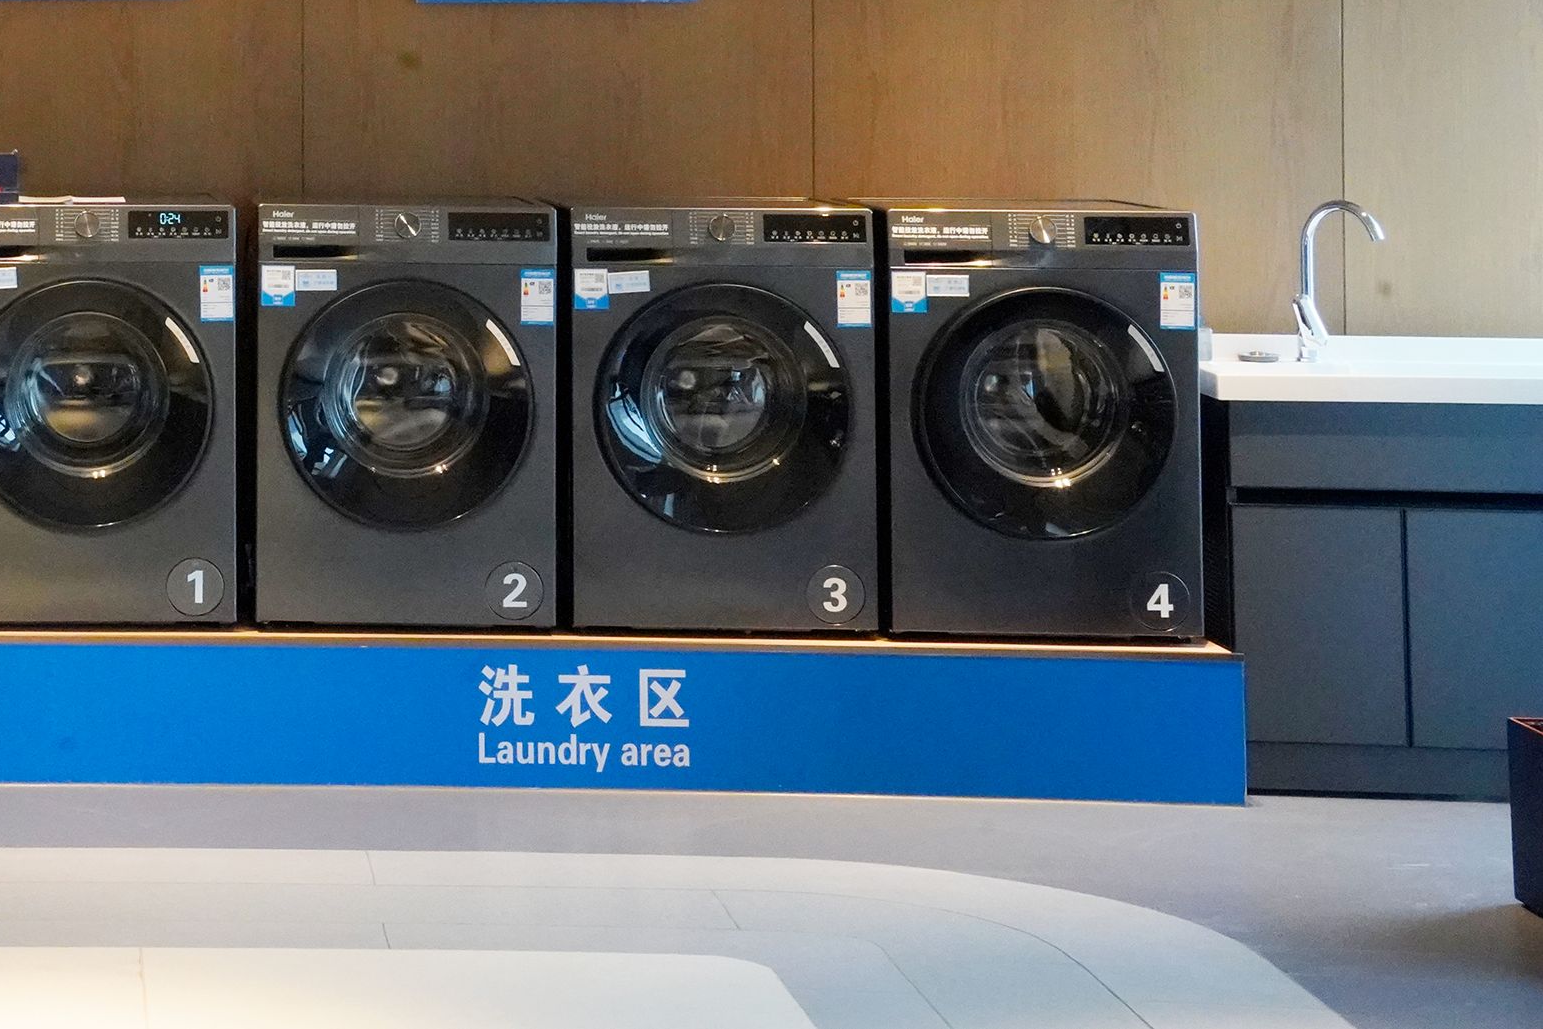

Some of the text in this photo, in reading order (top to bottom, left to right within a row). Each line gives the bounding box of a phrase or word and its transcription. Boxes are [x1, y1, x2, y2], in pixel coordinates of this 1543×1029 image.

[159, 212, 181, 225] 0:24
[272, 210, 295, 218] Haier
[585, 213, 607, 221] Haier
[901, 215, 925, 223] Haier
[187, 570, 204, 604] 1
[502, 572, 528, 608] 2
[822, 577, 848, 613] 3
[1146, 583, 1175, 619] 4
[478, 664, 690, 728] 洗衣区
[478, 732, 690, 772] Laundry area
